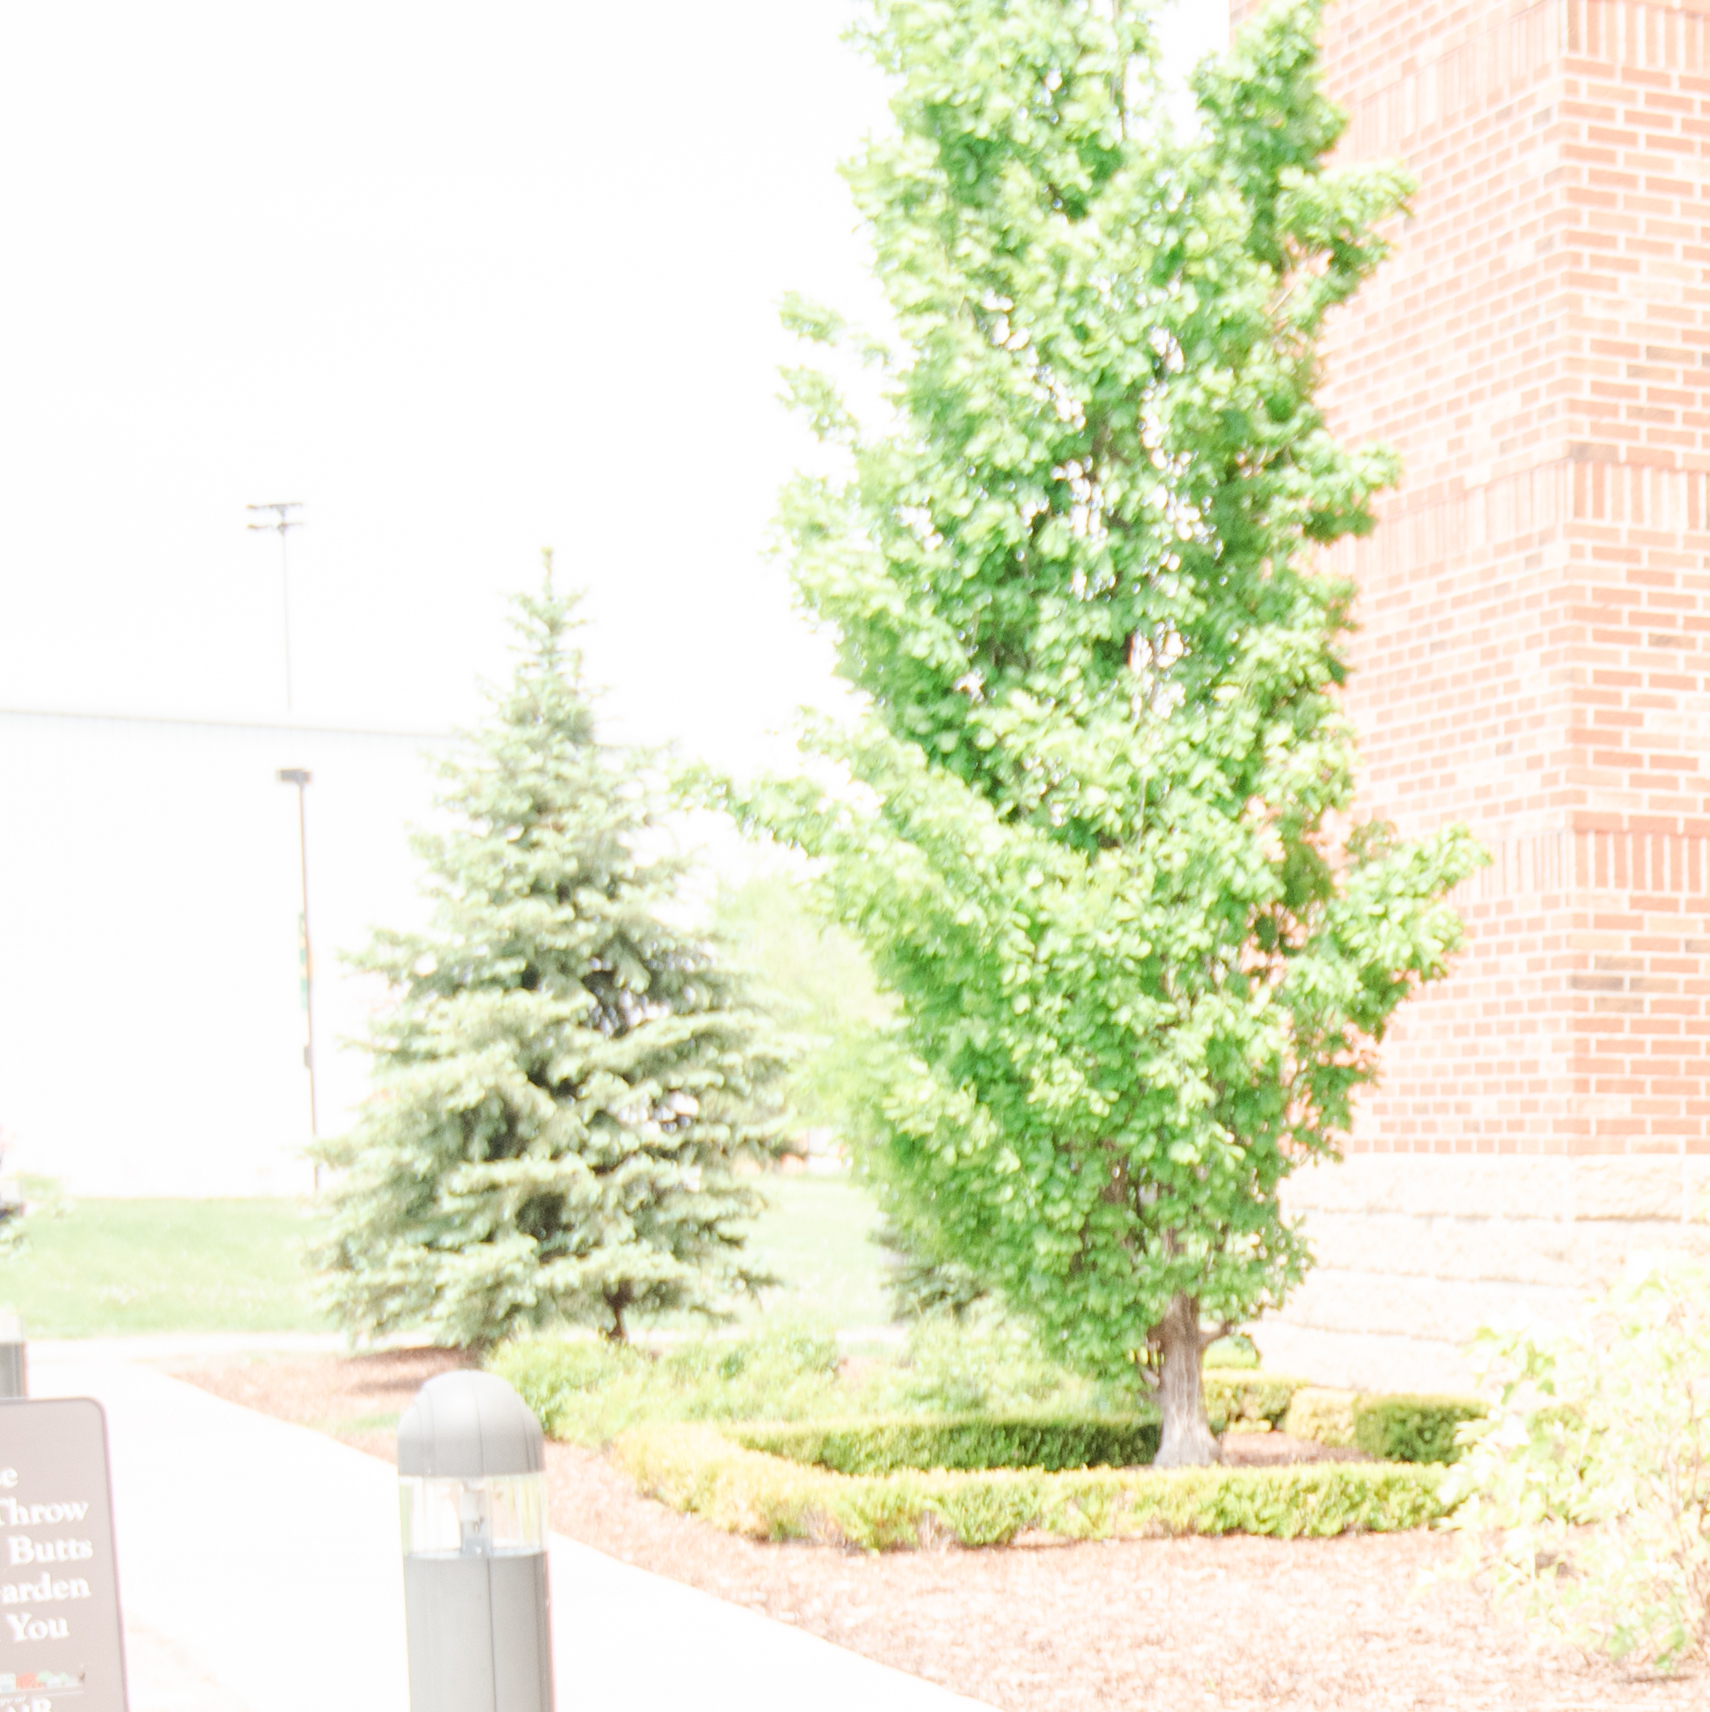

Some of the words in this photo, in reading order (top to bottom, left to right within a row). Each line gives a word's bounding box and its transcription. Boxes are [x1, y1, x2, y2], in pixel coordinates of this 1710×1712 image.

[7, 1533, 94, 1566] Butts
[0, 1570, 92, 1605] arden
[5, 1611, 70, 1643] You
